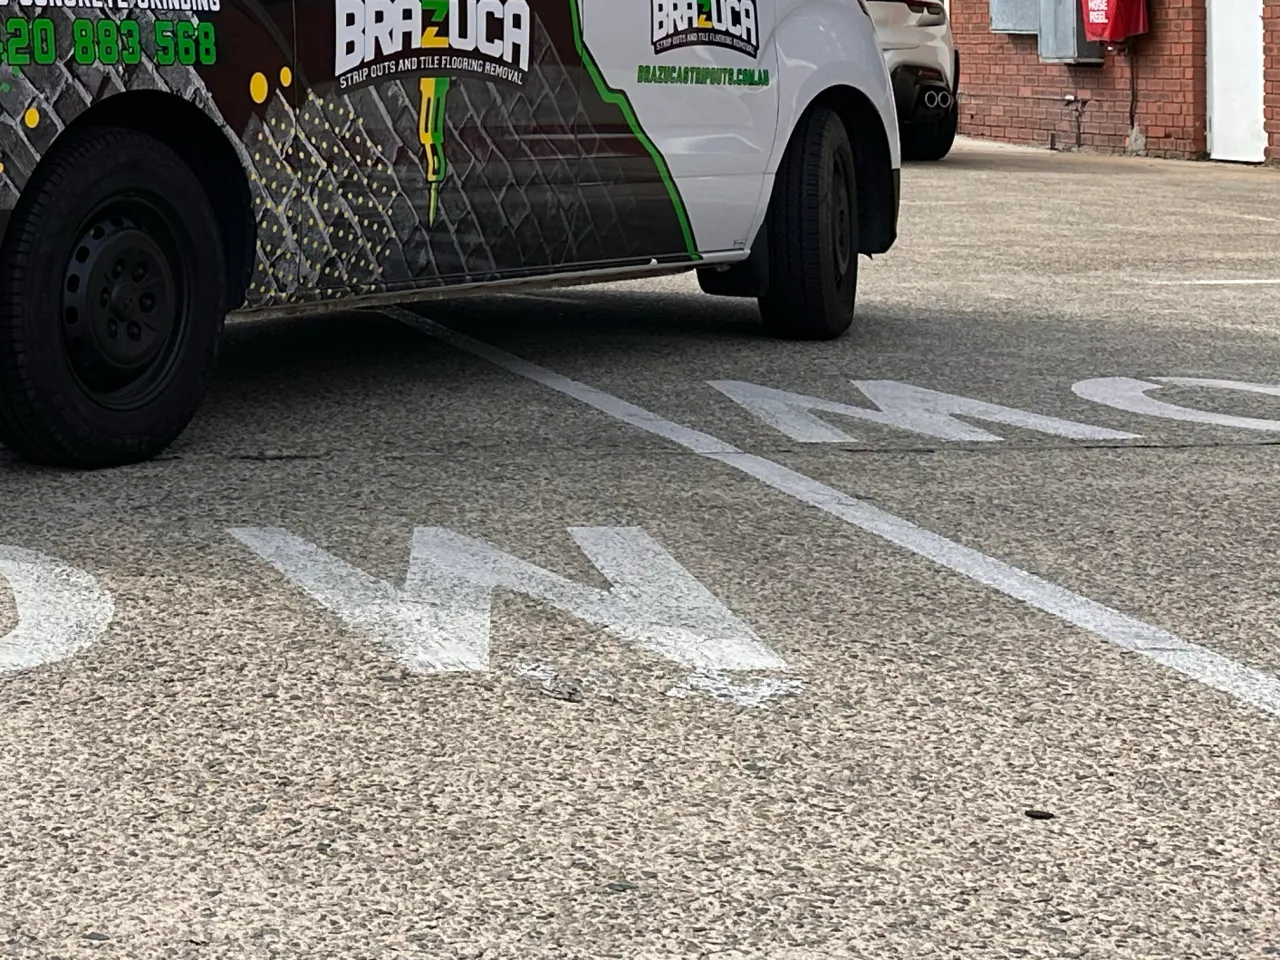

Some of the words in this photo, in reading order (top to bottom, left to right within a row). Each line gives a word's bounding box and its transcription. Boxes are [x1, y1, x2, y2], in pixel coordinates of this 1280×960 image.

[1089, 11, 1109, 24] REEL
[73, 17, 141, 66] 883
[154, 19, 217, 66] 568
[339, 68, 369, 89] STRIP
[371, 61, 396, 78] OUTS
[398, 58, 418, 72] AND
[419, 56, 440, 69] TILE
[441, 56, 483, 73] FLOORING
[485, 62, 523, 85] REMOVAL
[637, 65, 770, 86] BRAZUCASTRIPOUTS.COM.AU
